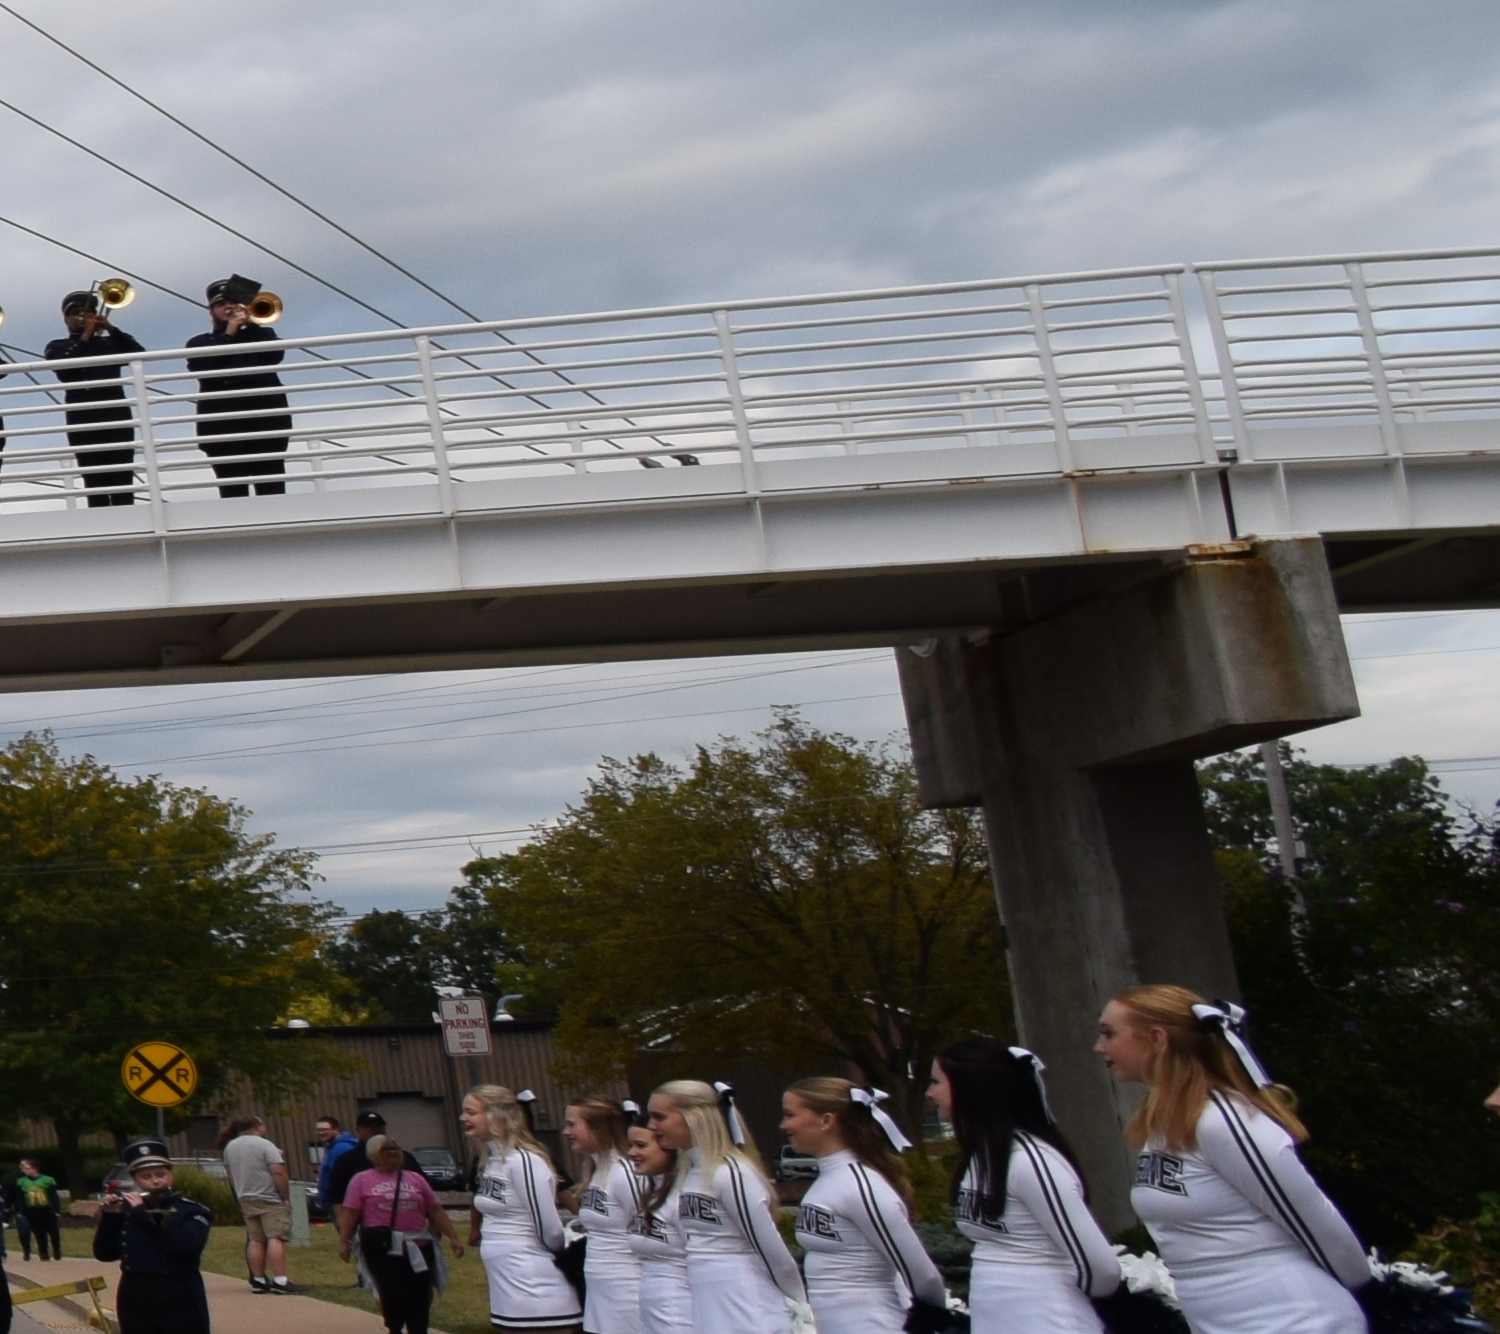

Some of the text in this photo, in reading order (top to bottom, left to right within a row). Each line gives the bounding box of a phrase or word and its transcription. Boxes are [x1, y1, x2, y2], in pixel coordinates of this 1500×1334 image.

[455, 1003, 469, 1015] NO
[444, 1018, 486, 1030] PARKING
[129, 1066, 189, 1083] R R
